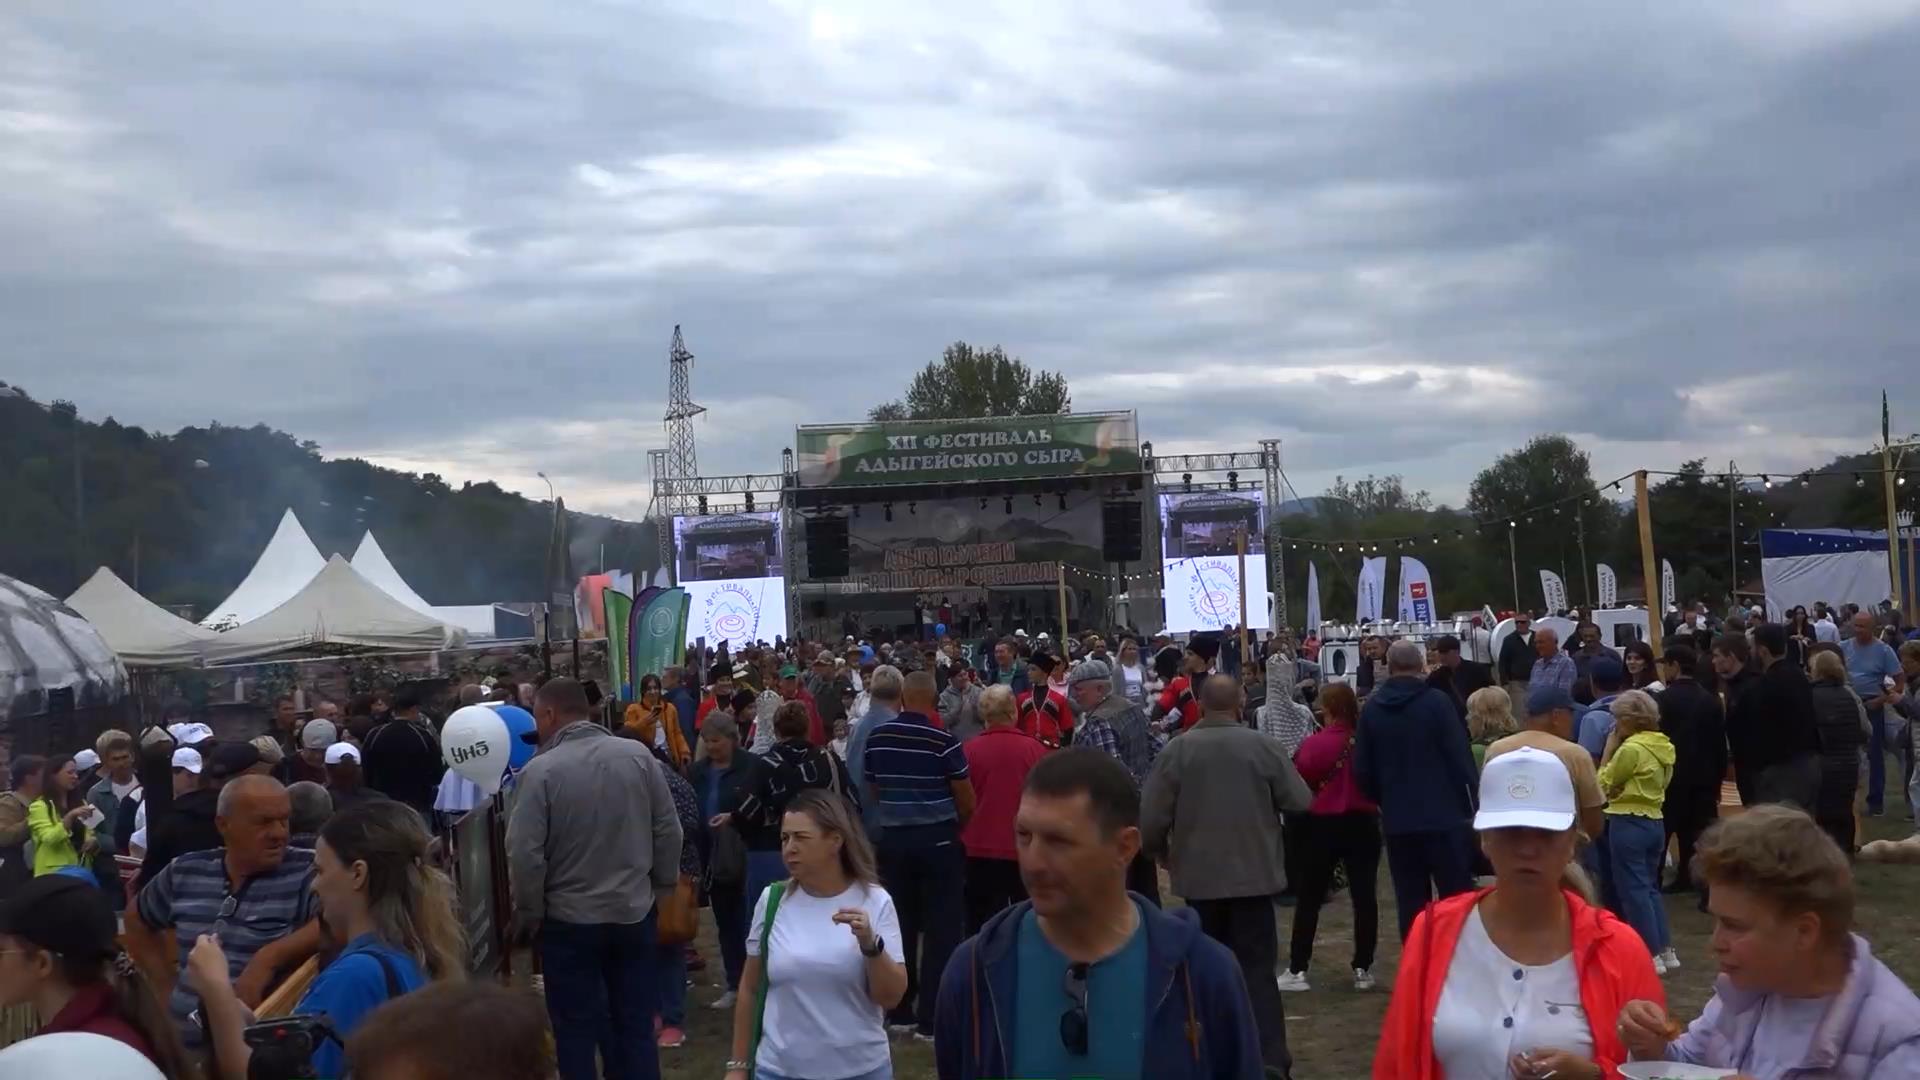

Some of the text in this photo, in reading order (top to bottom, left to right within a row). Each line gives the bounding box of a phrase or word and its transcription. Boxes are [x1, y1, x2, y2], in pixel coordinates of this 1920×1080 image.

[923, 429, 1053, 449] ФЕСТИВАЛЬ
[855, 448, 1085, 473] АДЫГЕЙСКОГО СЫРА
